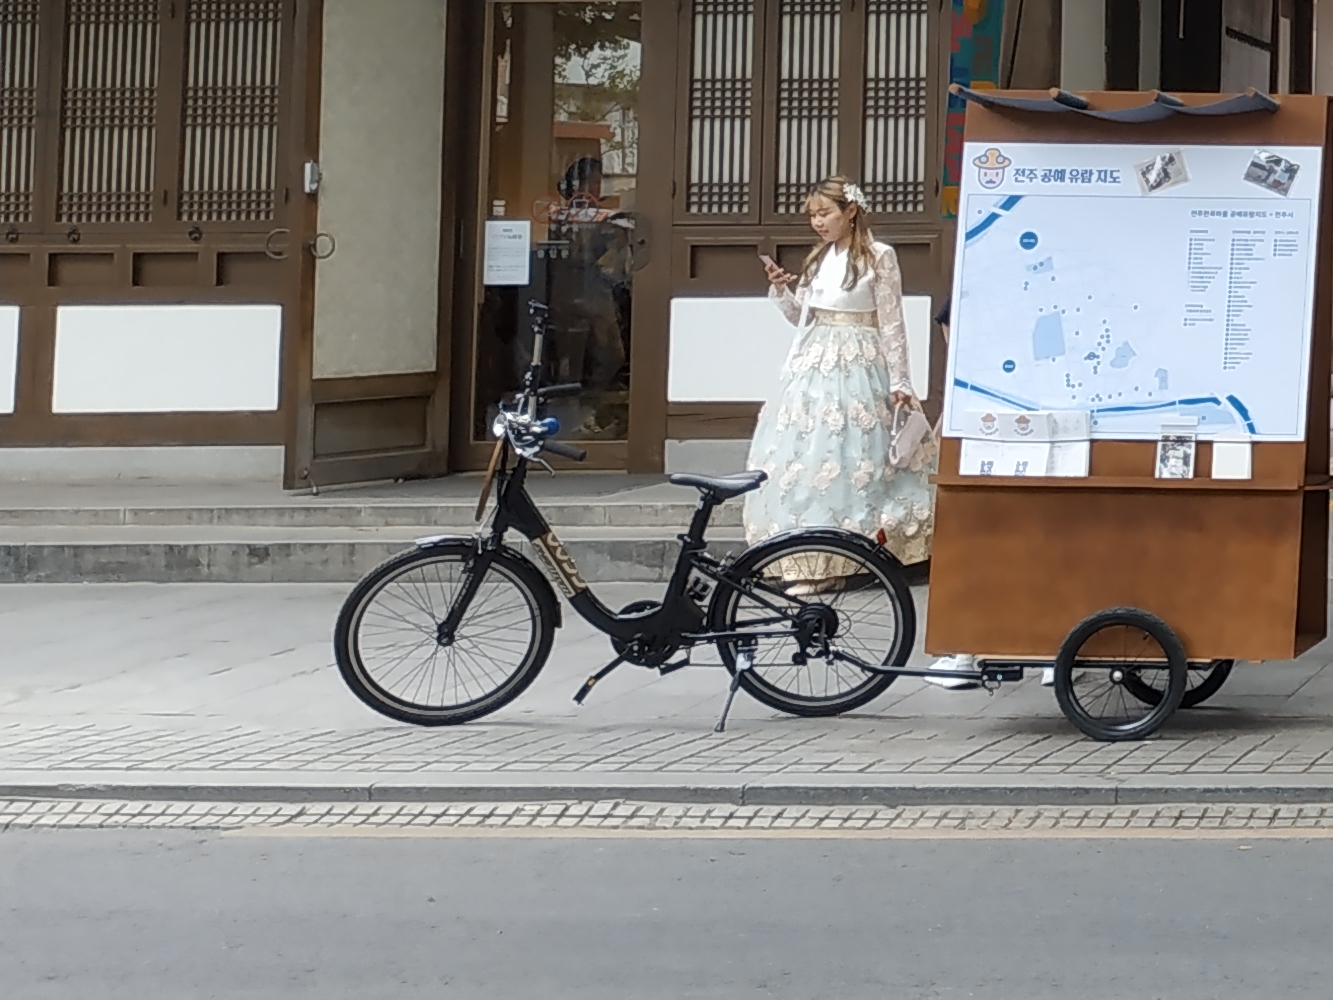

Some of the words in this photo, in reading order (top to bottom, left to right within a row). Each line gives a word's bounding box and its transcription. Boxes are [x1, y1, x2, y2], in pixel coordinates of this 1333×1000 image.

[1012, 167, 1039, 184] 전주
[1040, 167, 1066, 184] 공예
[1069, 168, 1095, 184] 유람
[1096, 169, 1122, 184] 지도
